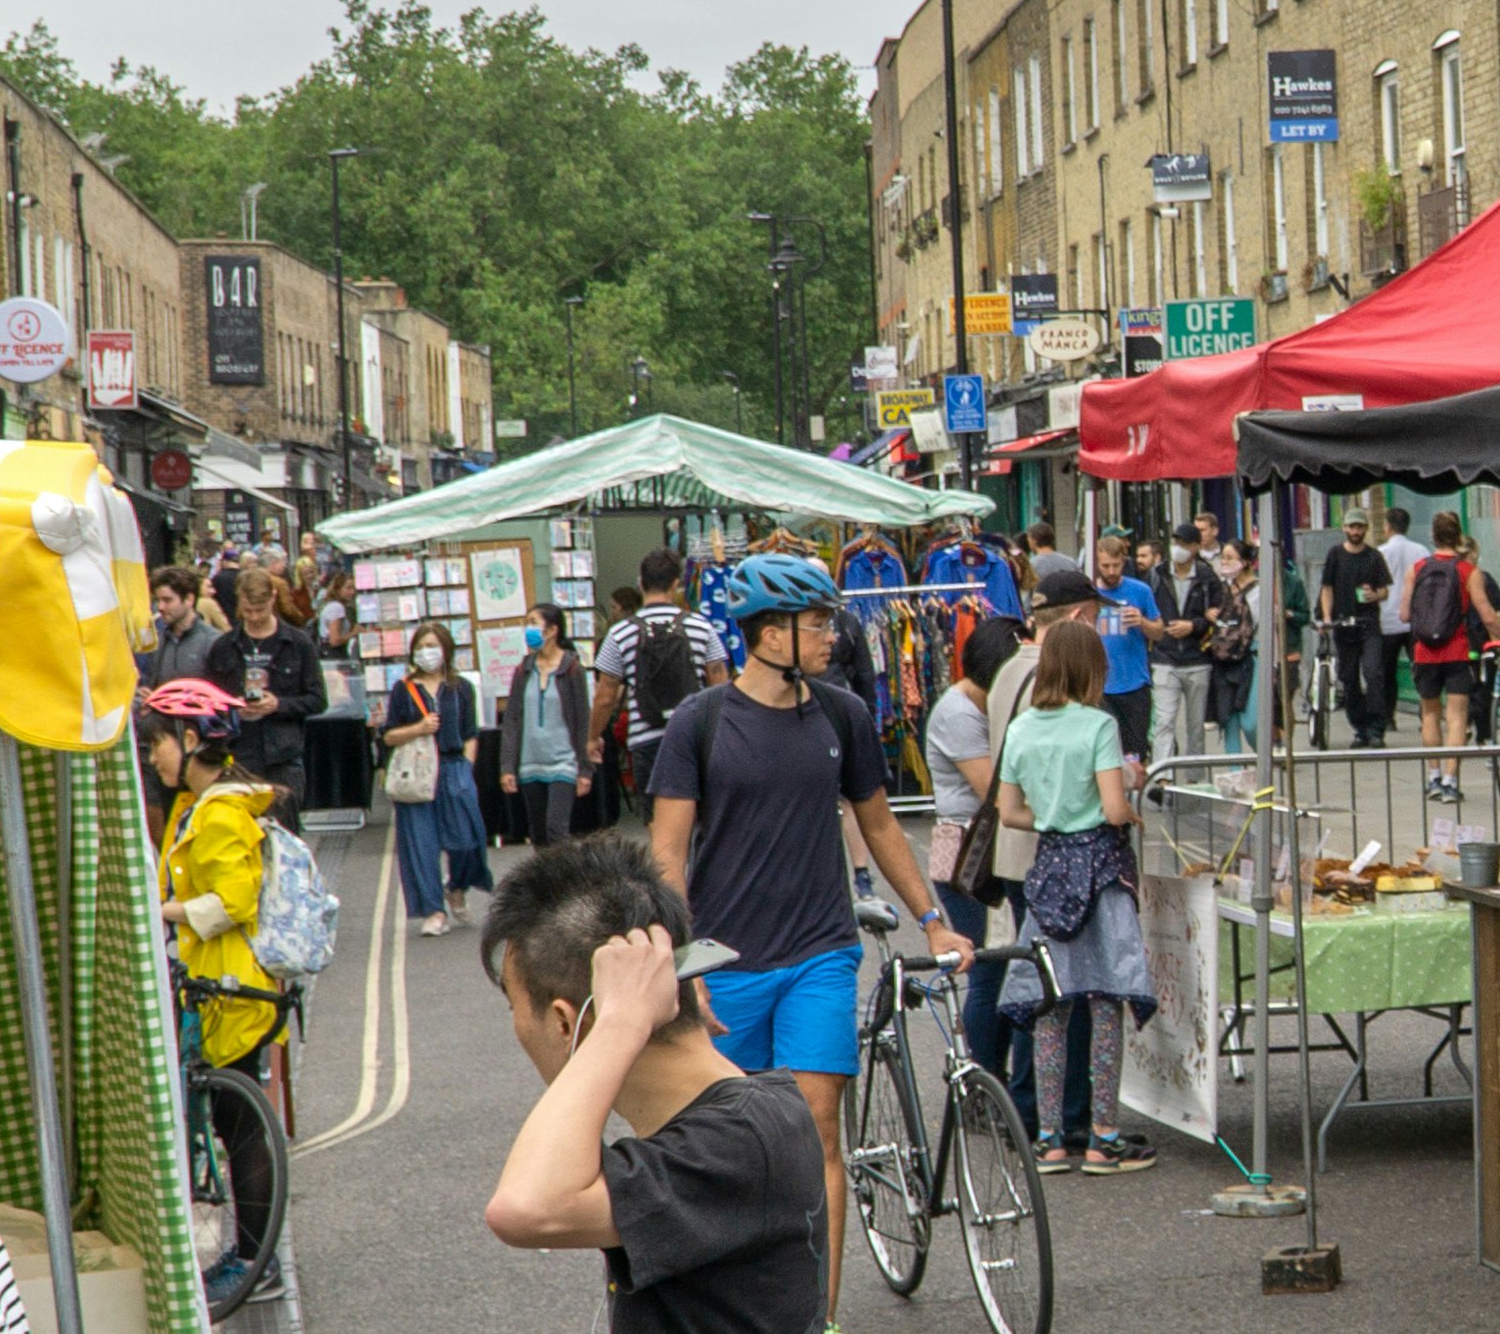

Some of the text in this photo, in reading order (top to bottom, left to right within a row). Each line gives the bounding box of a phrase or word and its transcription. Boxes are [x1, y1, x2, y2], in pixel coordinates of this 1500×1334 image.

[1273, 77, 1332, 96] Hawkes
[1281, 124, 1326, 137] LET BY
[212, 265, 258, 307] BAR
[1185, 303, 1235, 332] OFF
[1040, 329, 1089, 339] FRANCO
[13, 343, 64, 359] LICENCE
[1042, 339, 1089, 351] MANCA
[1170, 332, 1252, 357] LICENCE
[881, 394, 928, 405] BROADWAY
